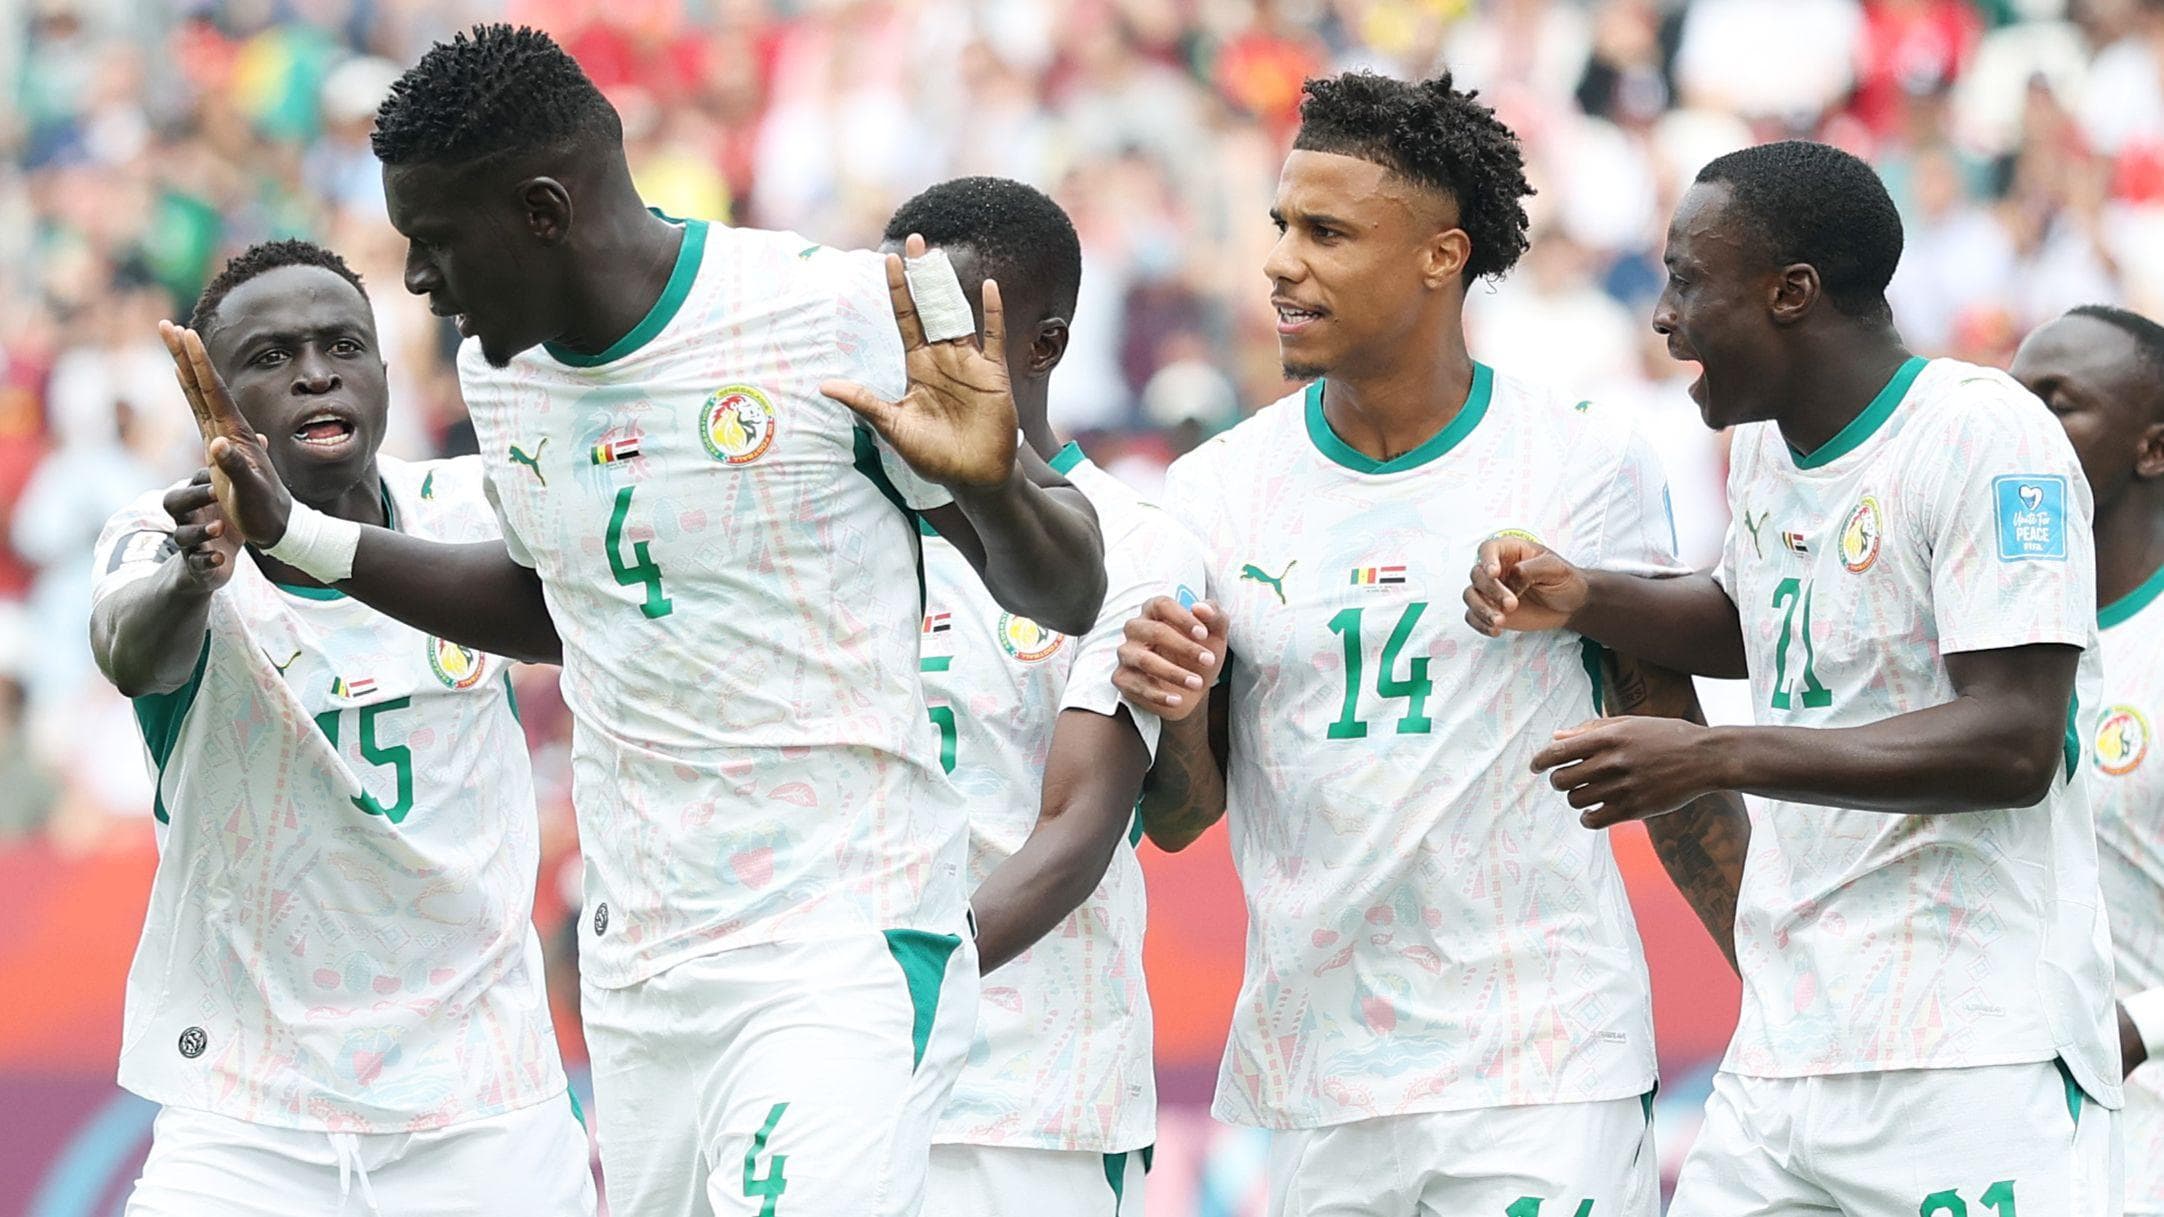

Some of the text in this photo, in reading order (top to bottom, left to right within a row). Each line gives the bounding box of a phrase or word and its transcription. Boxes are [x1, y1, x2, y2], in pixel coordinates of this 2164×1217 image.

[605, 485, 673, 619] 4
[2015, 526, 2051, 542] PEACE
[1327, 602, 1434, 739] 14
[1770, 577, 1833, 711] 21
[742, 1102, 792, 1217] 4
